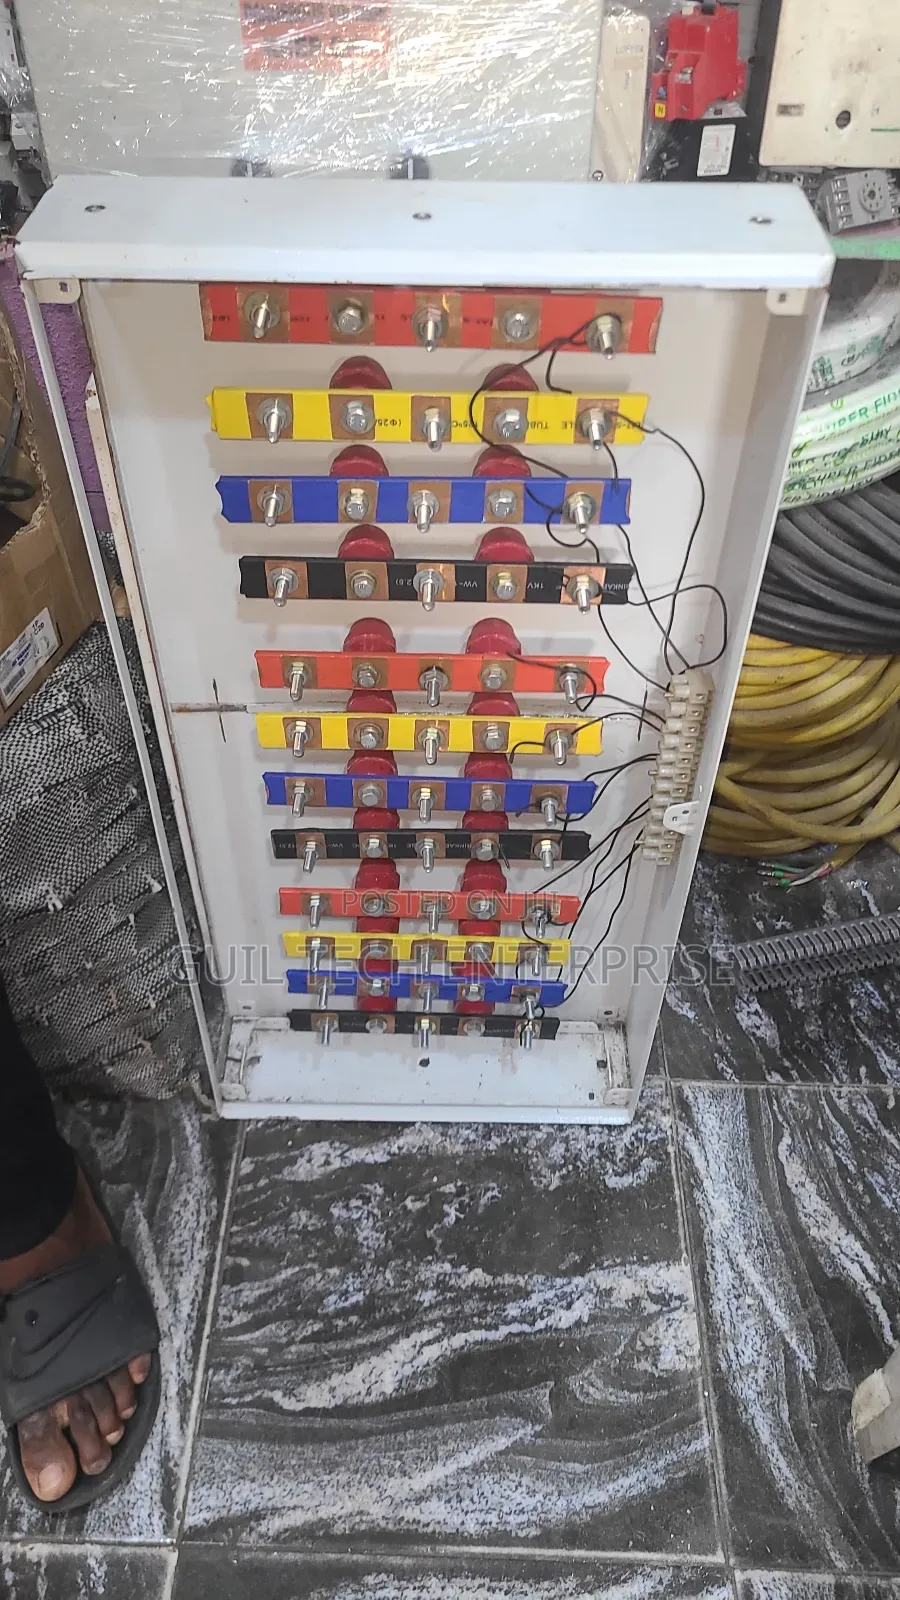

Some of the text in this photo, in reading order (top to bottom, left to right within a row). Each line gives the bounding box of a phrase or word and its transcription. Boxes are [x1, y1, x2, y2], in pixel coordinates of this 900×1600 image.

[658, 105, 664, 114] N
[527, 421, 549, 431] TUB
[395, 577, 412, 587] 2.5)
